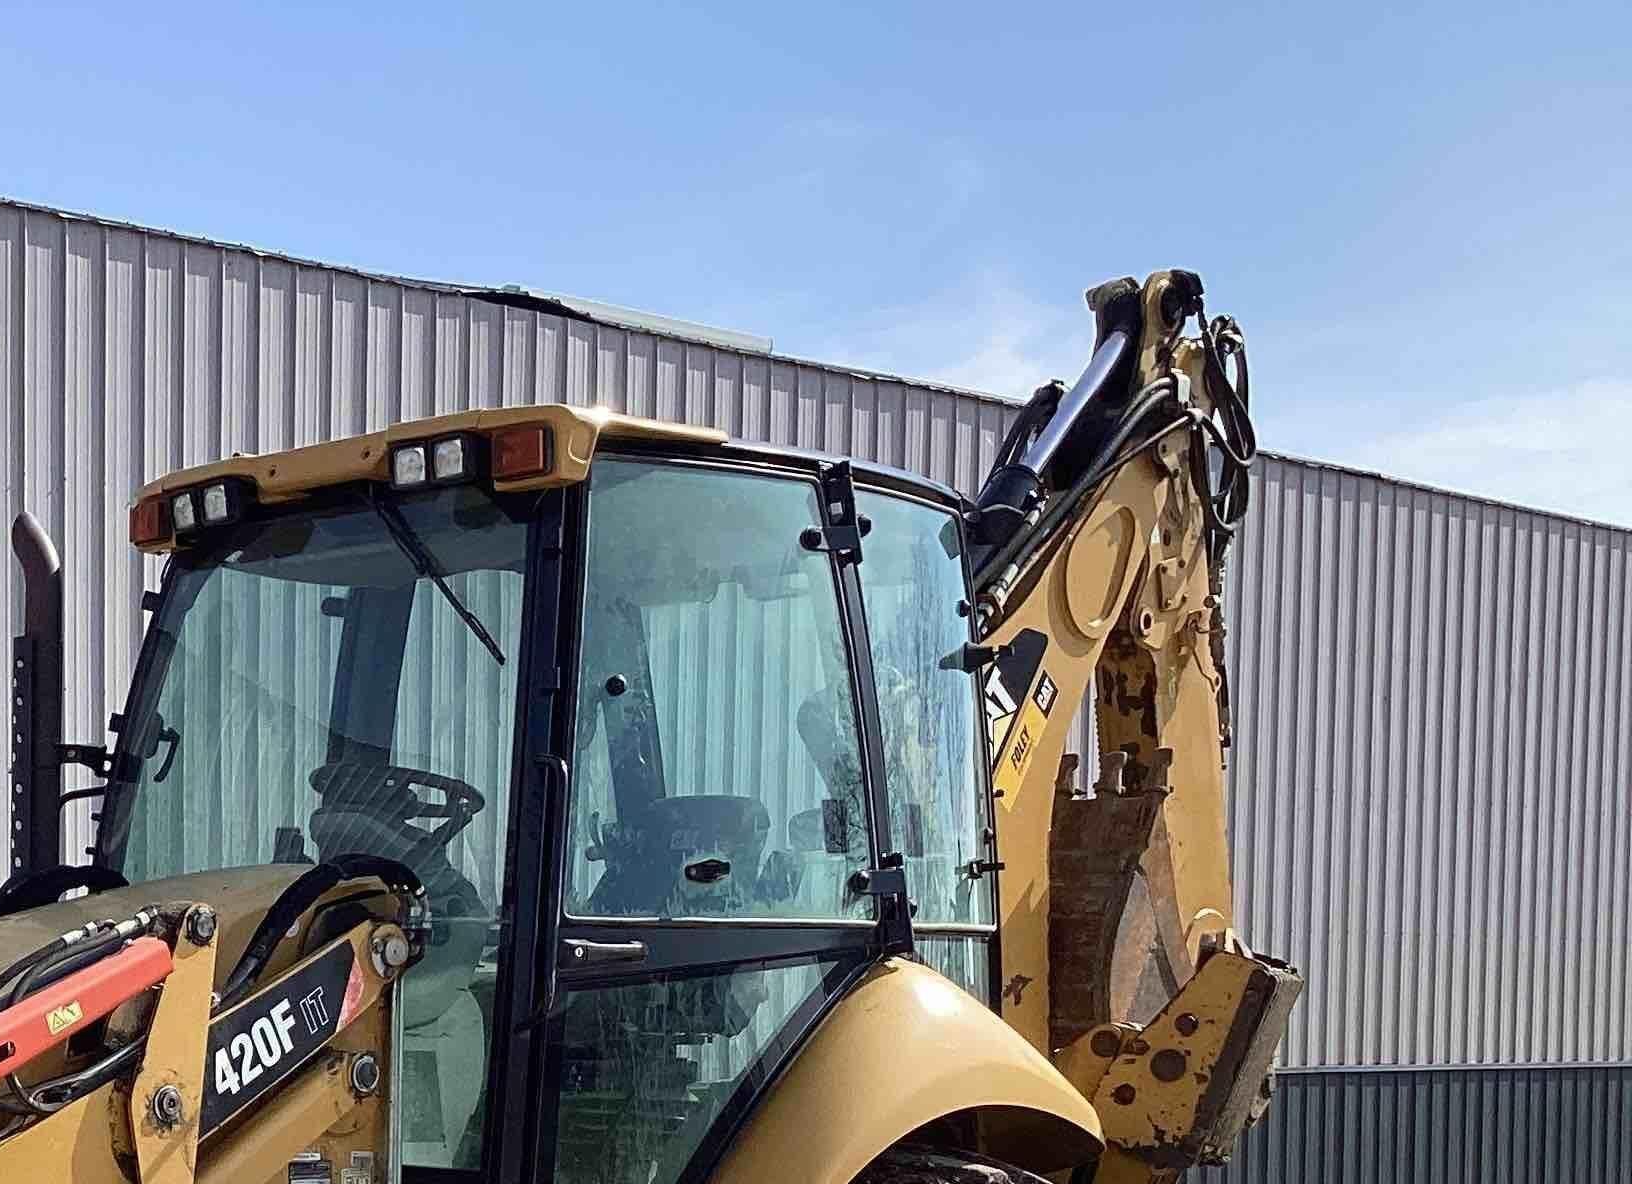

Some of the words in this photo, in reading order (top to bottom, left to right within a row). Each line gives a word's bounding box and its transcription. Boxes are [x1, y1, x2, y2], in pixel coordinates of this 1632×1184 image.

[1036, 676, 1055, 712] CAT
[1010, 724, 1031, 771] FOLEY
[214, 997, 297, 1096] 420F
[299, 985, 330, 1035] IT
